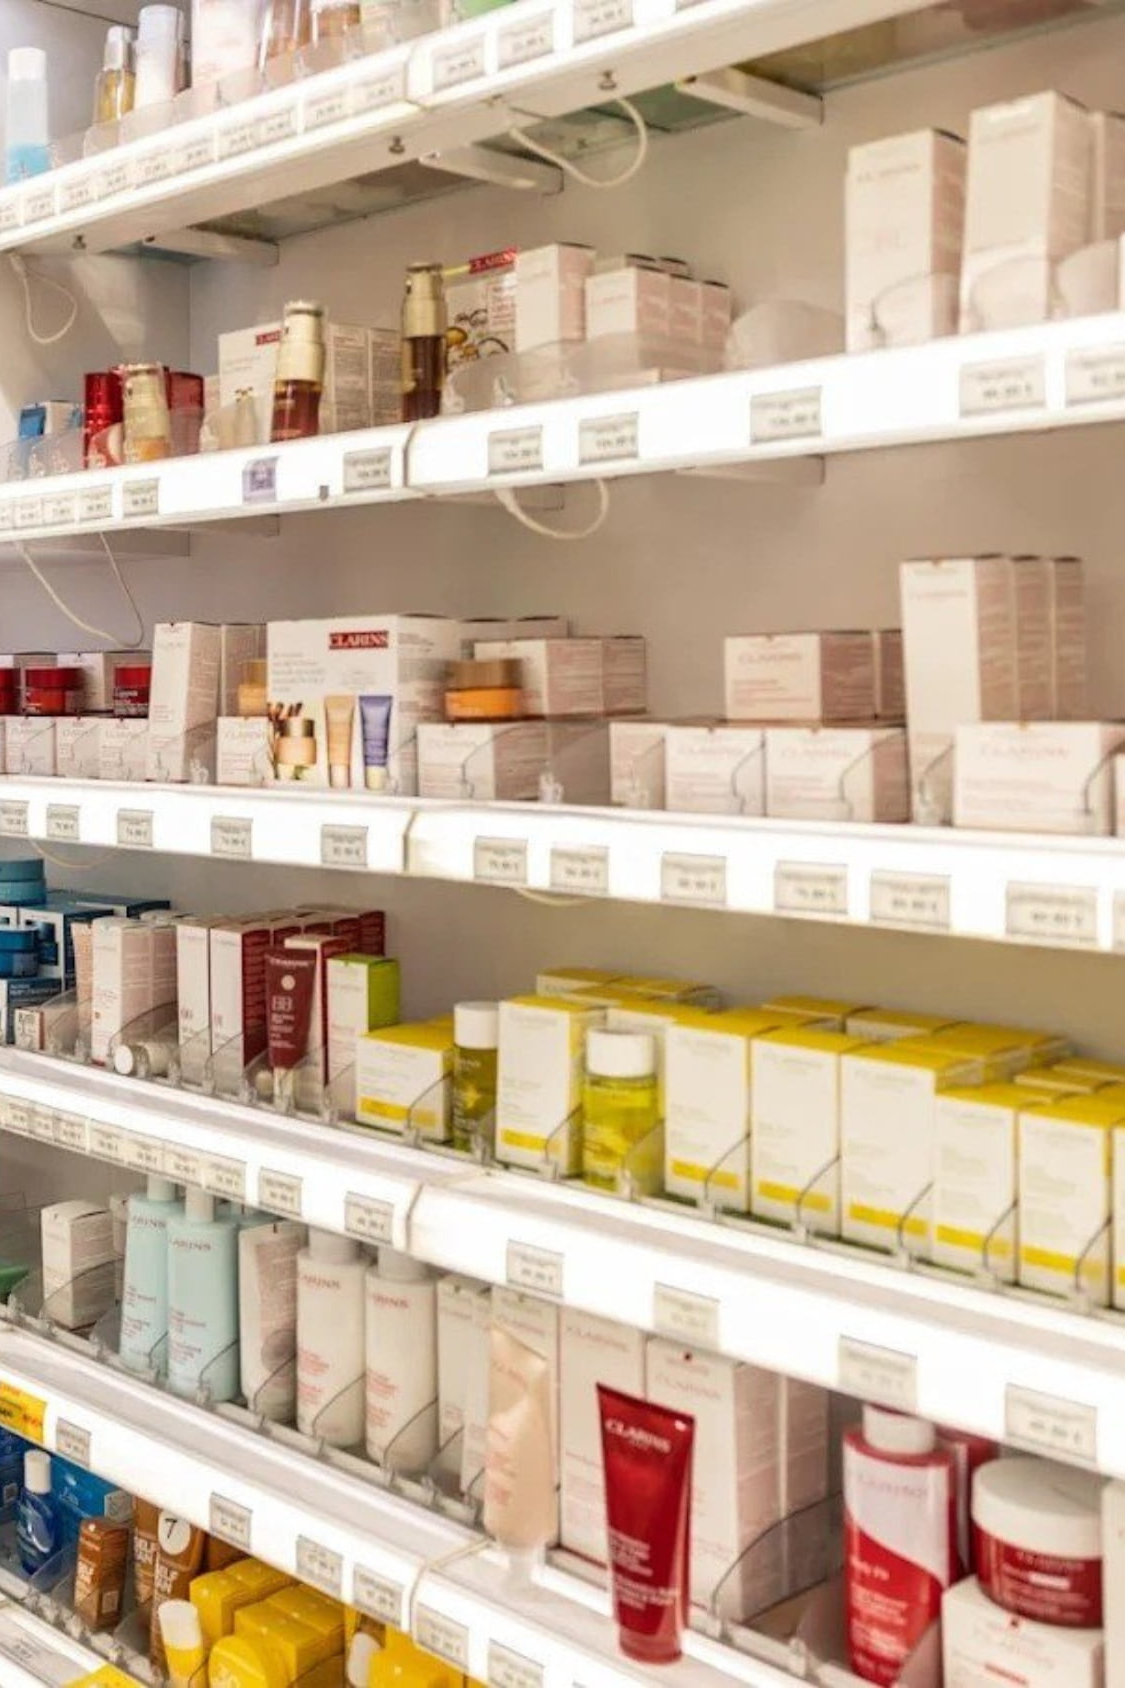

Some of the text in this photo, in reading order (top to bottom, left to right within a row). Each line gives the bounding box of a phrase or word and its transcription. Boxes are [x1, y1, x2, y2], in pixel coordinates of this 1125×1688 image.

[330, 631, 388, 648] CLARINS
[604, 1418, 673, 1452] CLARINS
[164, 1518, 178, 1539] 7
